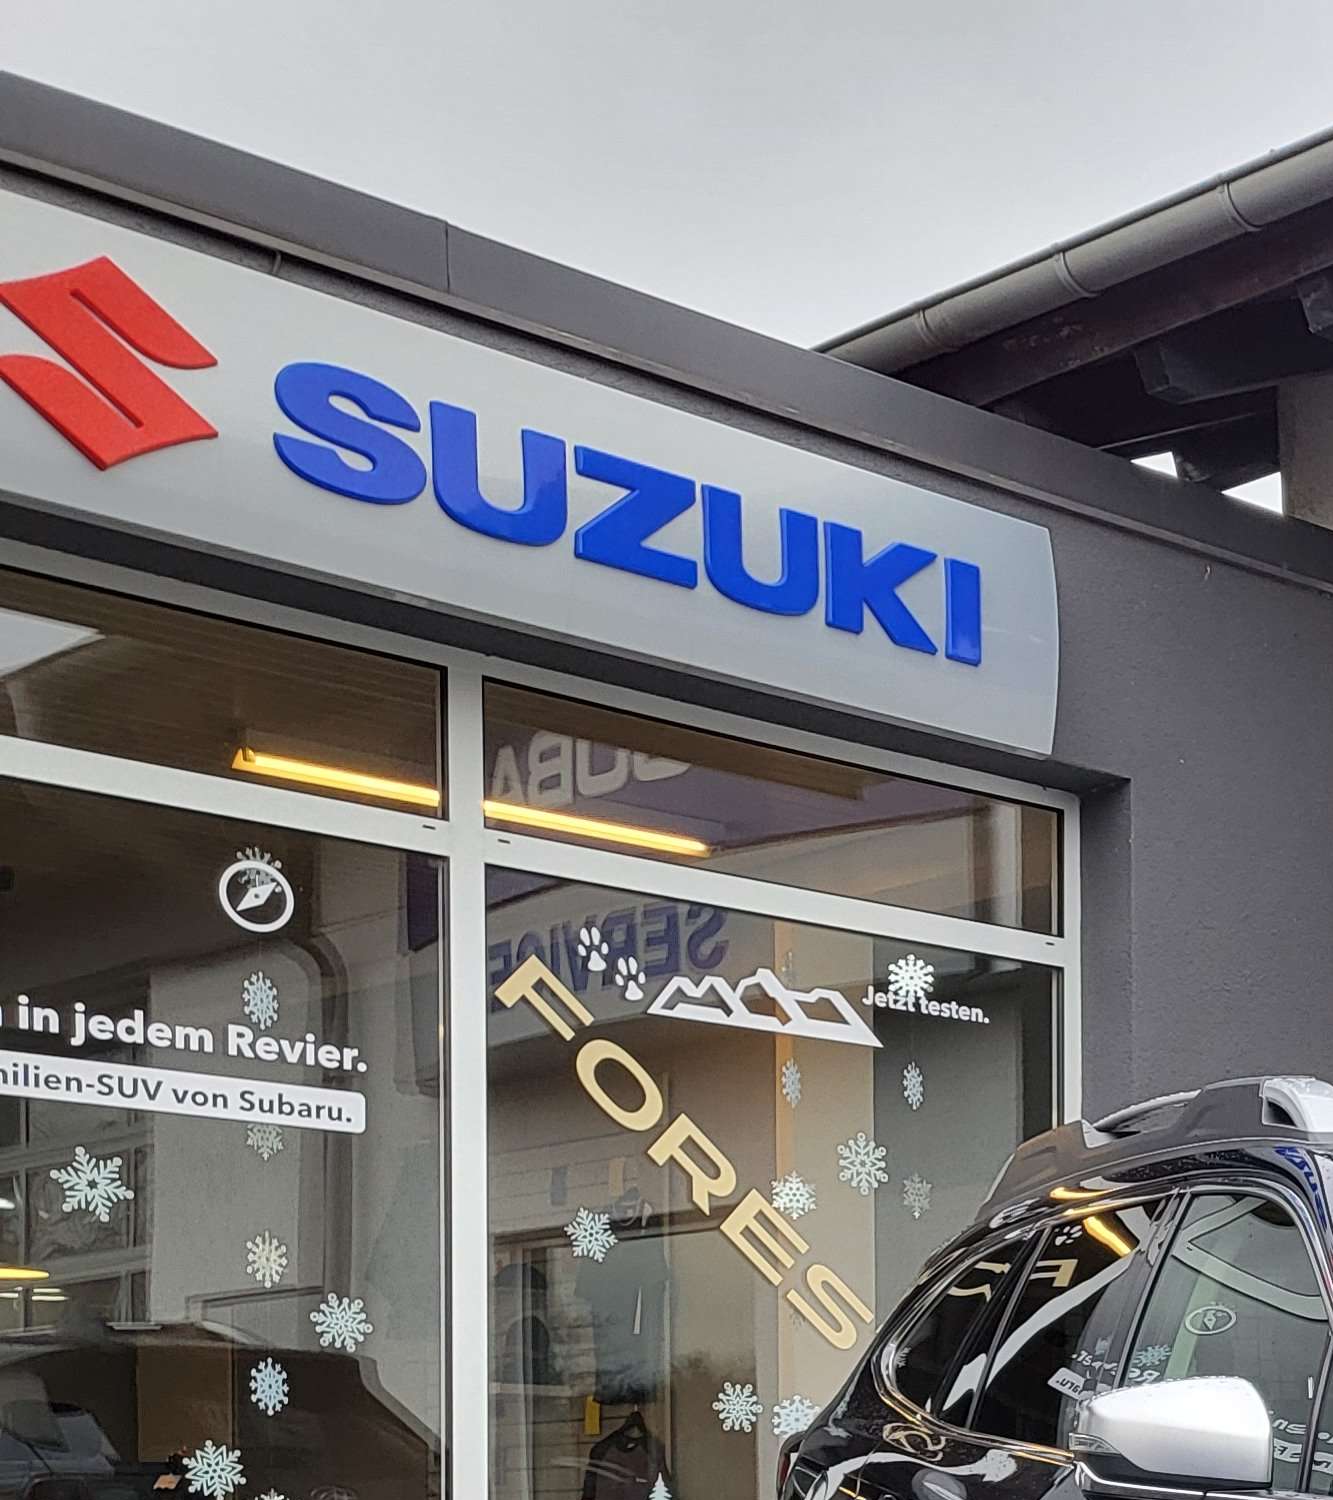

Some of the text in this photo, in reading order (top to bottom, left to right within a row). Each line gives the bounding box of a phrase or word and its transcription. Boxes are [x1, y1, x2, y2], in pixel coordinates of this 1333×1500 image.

[273, 361, 982, 667] SUZUKI
[17, 994, 368, 1073] in jedem Revier.
[862, 985, 991, 1024] Jetzt testen.
[171, 1087, 229, 1111] von
[239, 1090, 353, 1123] Subaru.
[494, 954, 874, 1350] FORES
